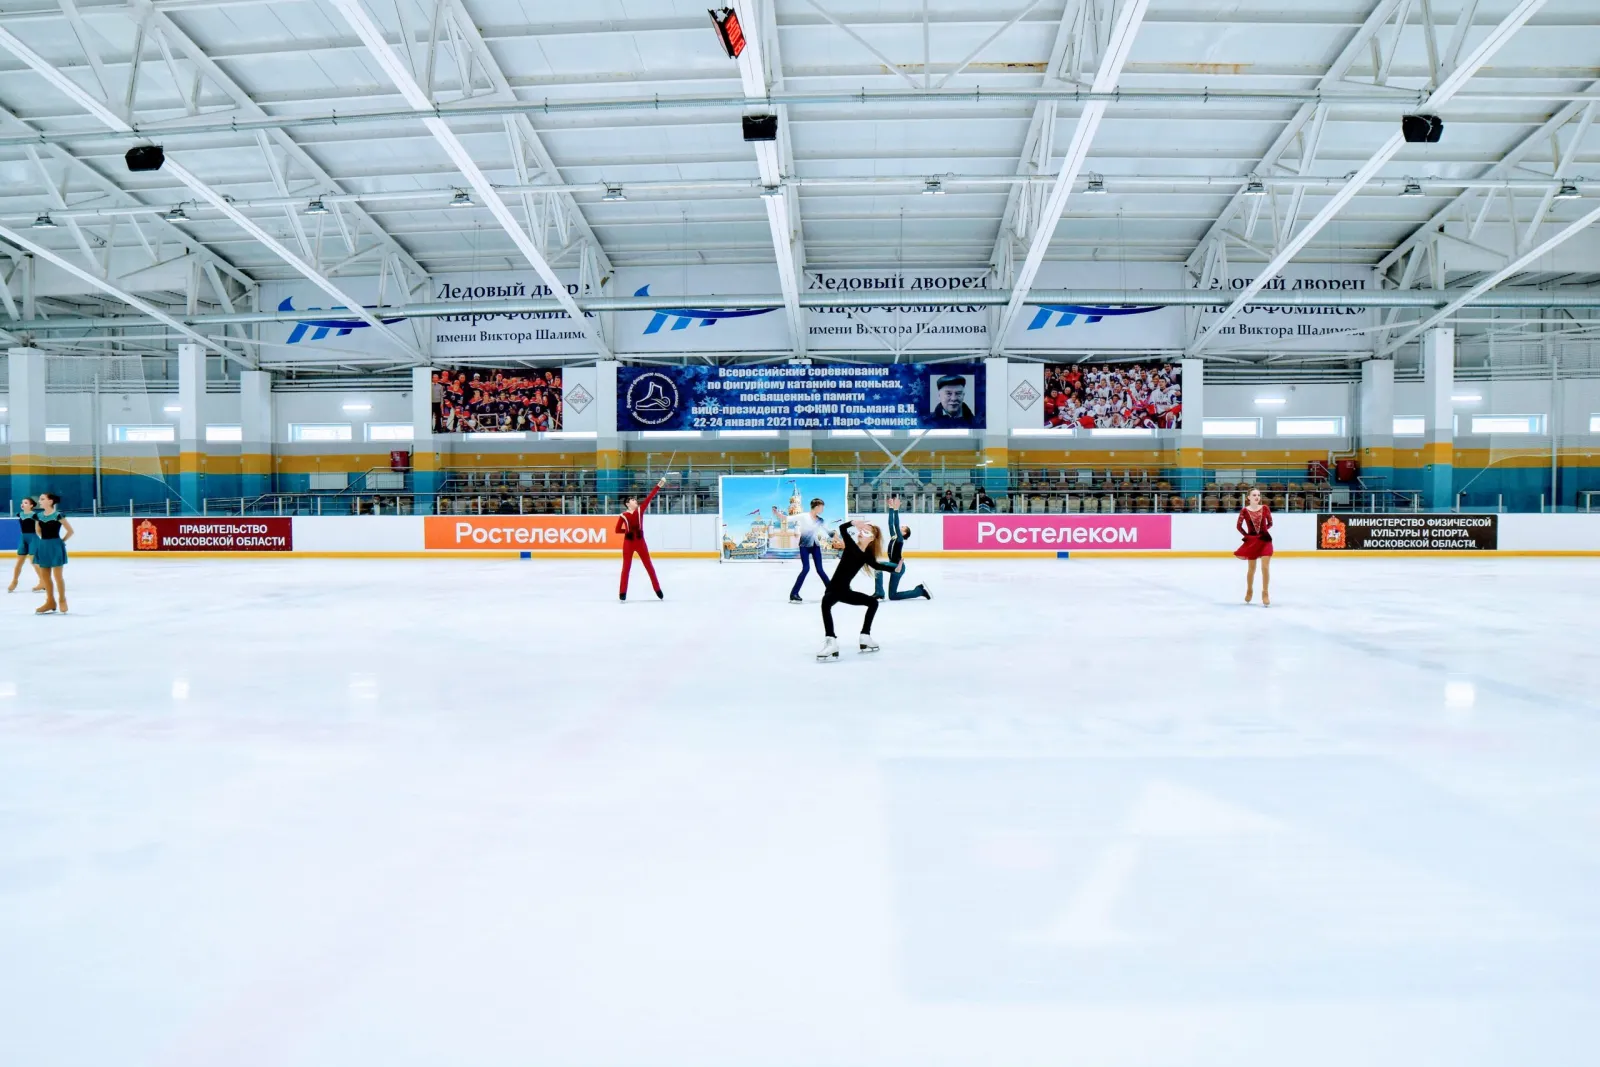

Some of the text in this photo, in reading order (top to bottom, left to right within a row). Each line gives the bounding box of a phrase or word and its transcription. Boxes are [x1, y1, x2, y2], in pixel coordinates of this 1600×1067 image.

[437, 282, 525, 300] Ледовый
[856, 324, 912, 337] Виктора
[916, 323, 987, 334] Шалимова
[1239, 324, 1293, 338] Виктора
[437, 334, 476, 342] имени
[480, 331, 532, 343] Виктора
[718, 367, 889, 377] Всероссийские соревнования
[707, 380, 903, 390] по фигурному катанию на коньках,
[740, 392, 865, 402] посвященные памяти
[691, 403, 917, 415] вице-президента ФФКМО Гольмана В.Н.
[693, 417, 917, 427] 22-24 января 2021 года, г. Наро-Фоминск
[1349, 517, 1492, 527] МИНИСТЕРСТВО ФИЗИЧЕСКОЙ
[179, 524, 268, 534] ПРАВИТЕЛЬСТВО
[455, 522, 607, 543] Ростелеком
[977, 522, 1137, 543] Ростелеком
[1371, 529, 1469, 537] КУЛЬТУРЫ И СПОРТА
[162, 535, 286, 546] МОСКОВСКОЙ ОБЛАСТИ
[1363, 538, 1476, 548] МОСКОВСКОЙ ОБЛАСТИ
